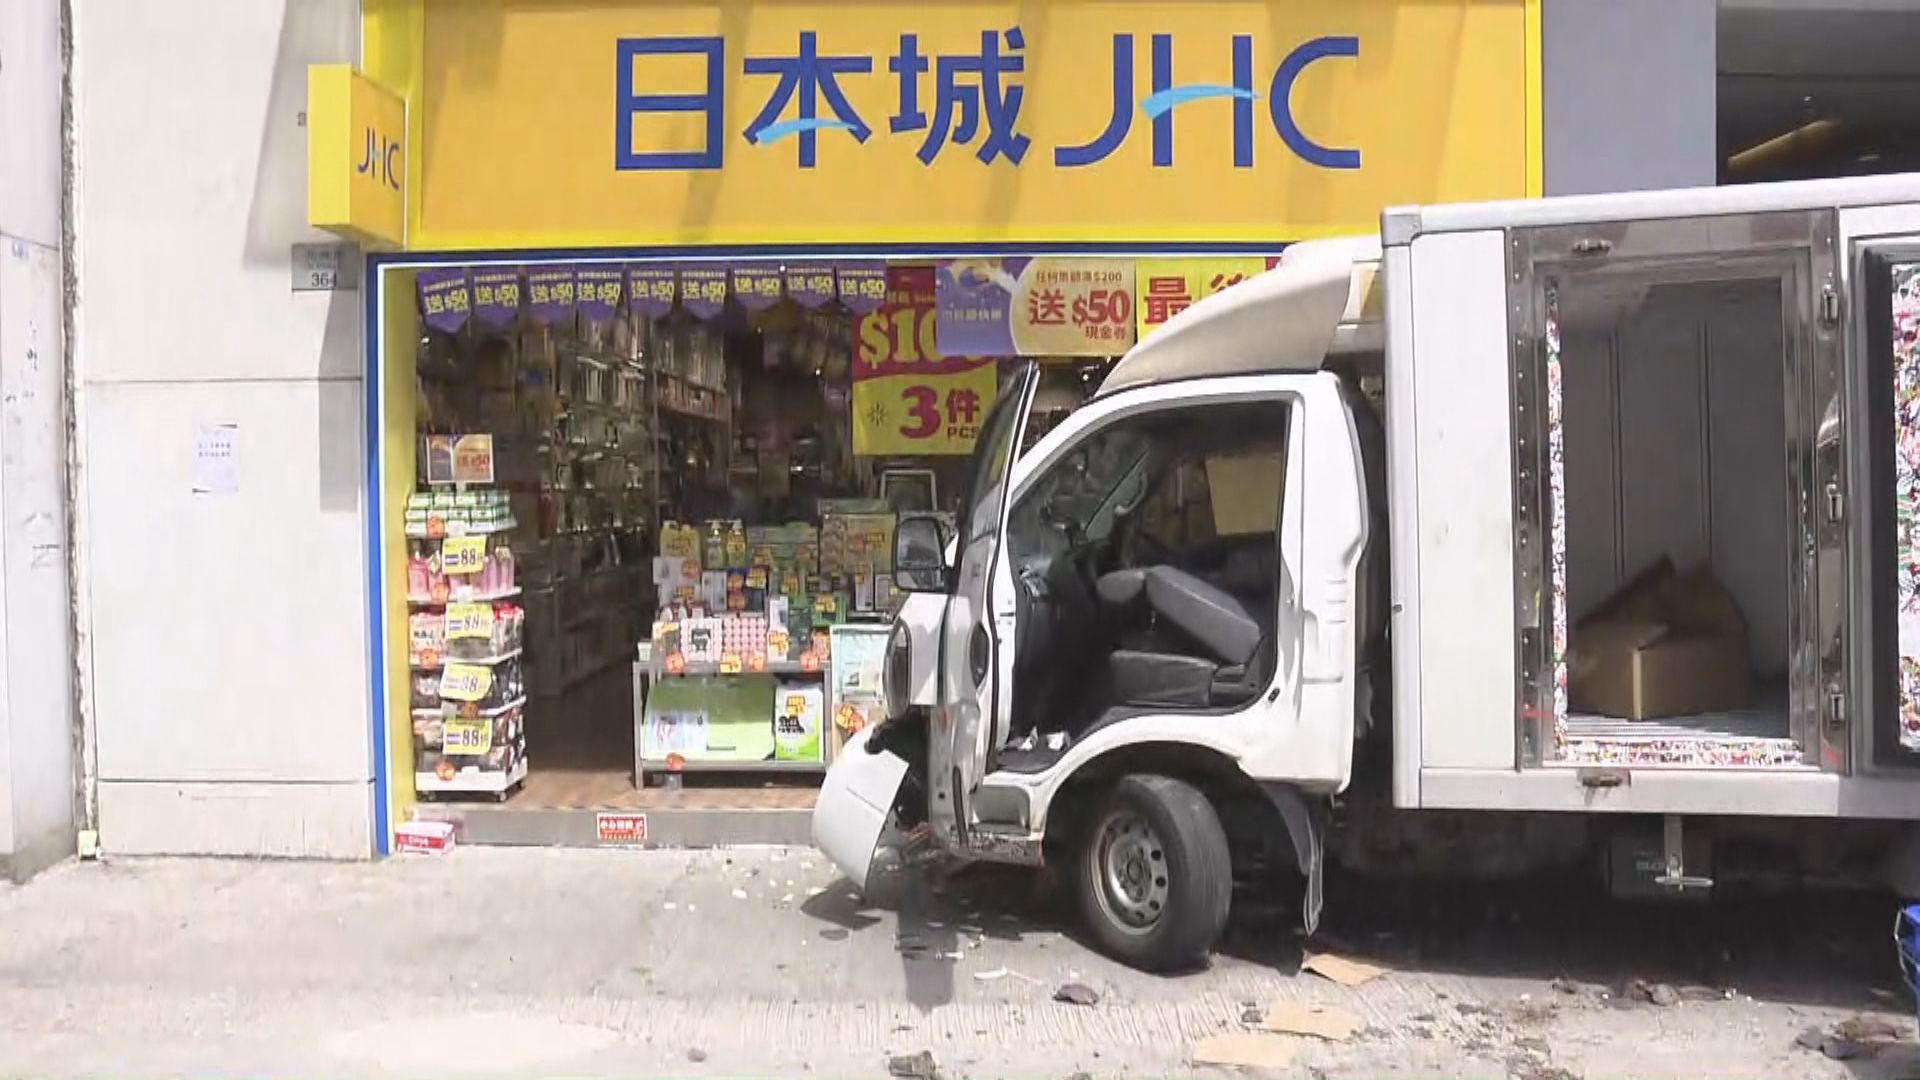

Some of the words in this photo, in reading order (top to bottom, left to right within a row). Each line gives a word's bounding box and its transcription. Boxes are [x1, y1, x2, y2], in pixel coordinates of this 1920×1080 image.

[615, 27, 1031, 171] 日本城
[1054, 34, 1361, 168] JHC
[357, 128, 400, 190] JHC
[311, 272, 337, 287] 364
[1144, 273, 1248, 325] 最
[1029, 289, 1066, 325] 送
[1072, 289, 1131, 328] $50
[860, 307, 965, 369] $10
[899, 385, 941, 439] 3
[946, 388, 980, 424] 件
[947, 426, 980, 439] PCS
[463, 729, 479, 746] 88
